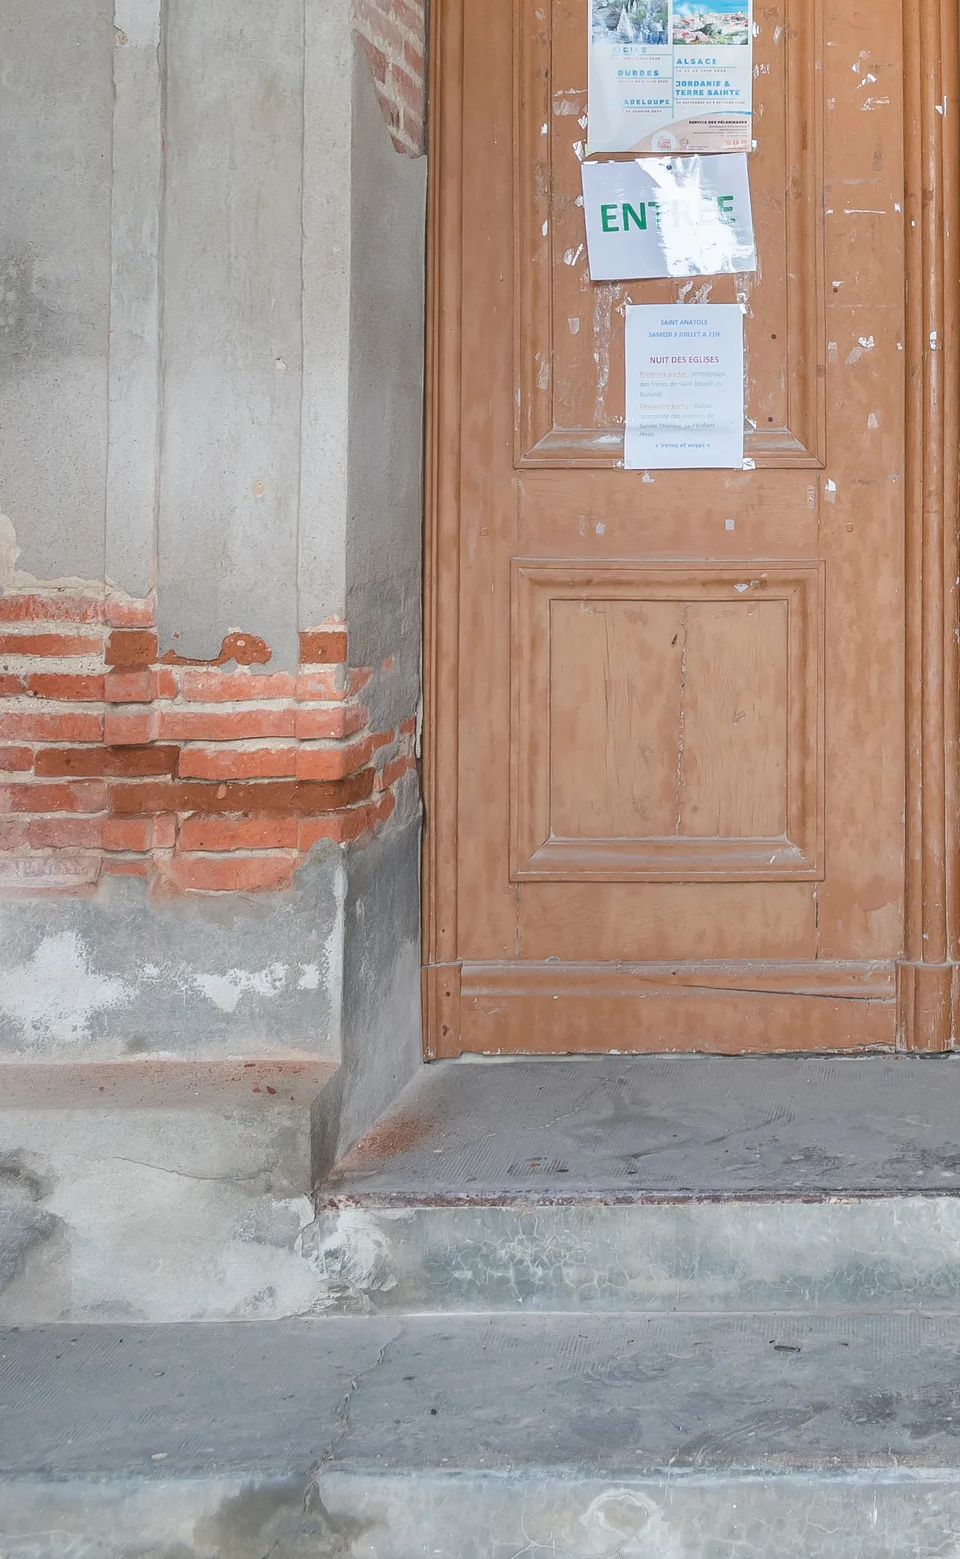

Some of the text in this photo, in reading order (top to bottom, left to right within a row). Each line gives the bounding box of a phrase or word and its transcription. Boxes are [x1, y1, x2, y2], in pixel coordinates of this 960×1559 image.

[649, 356, 720, 364] NUIT DES EGLISES
